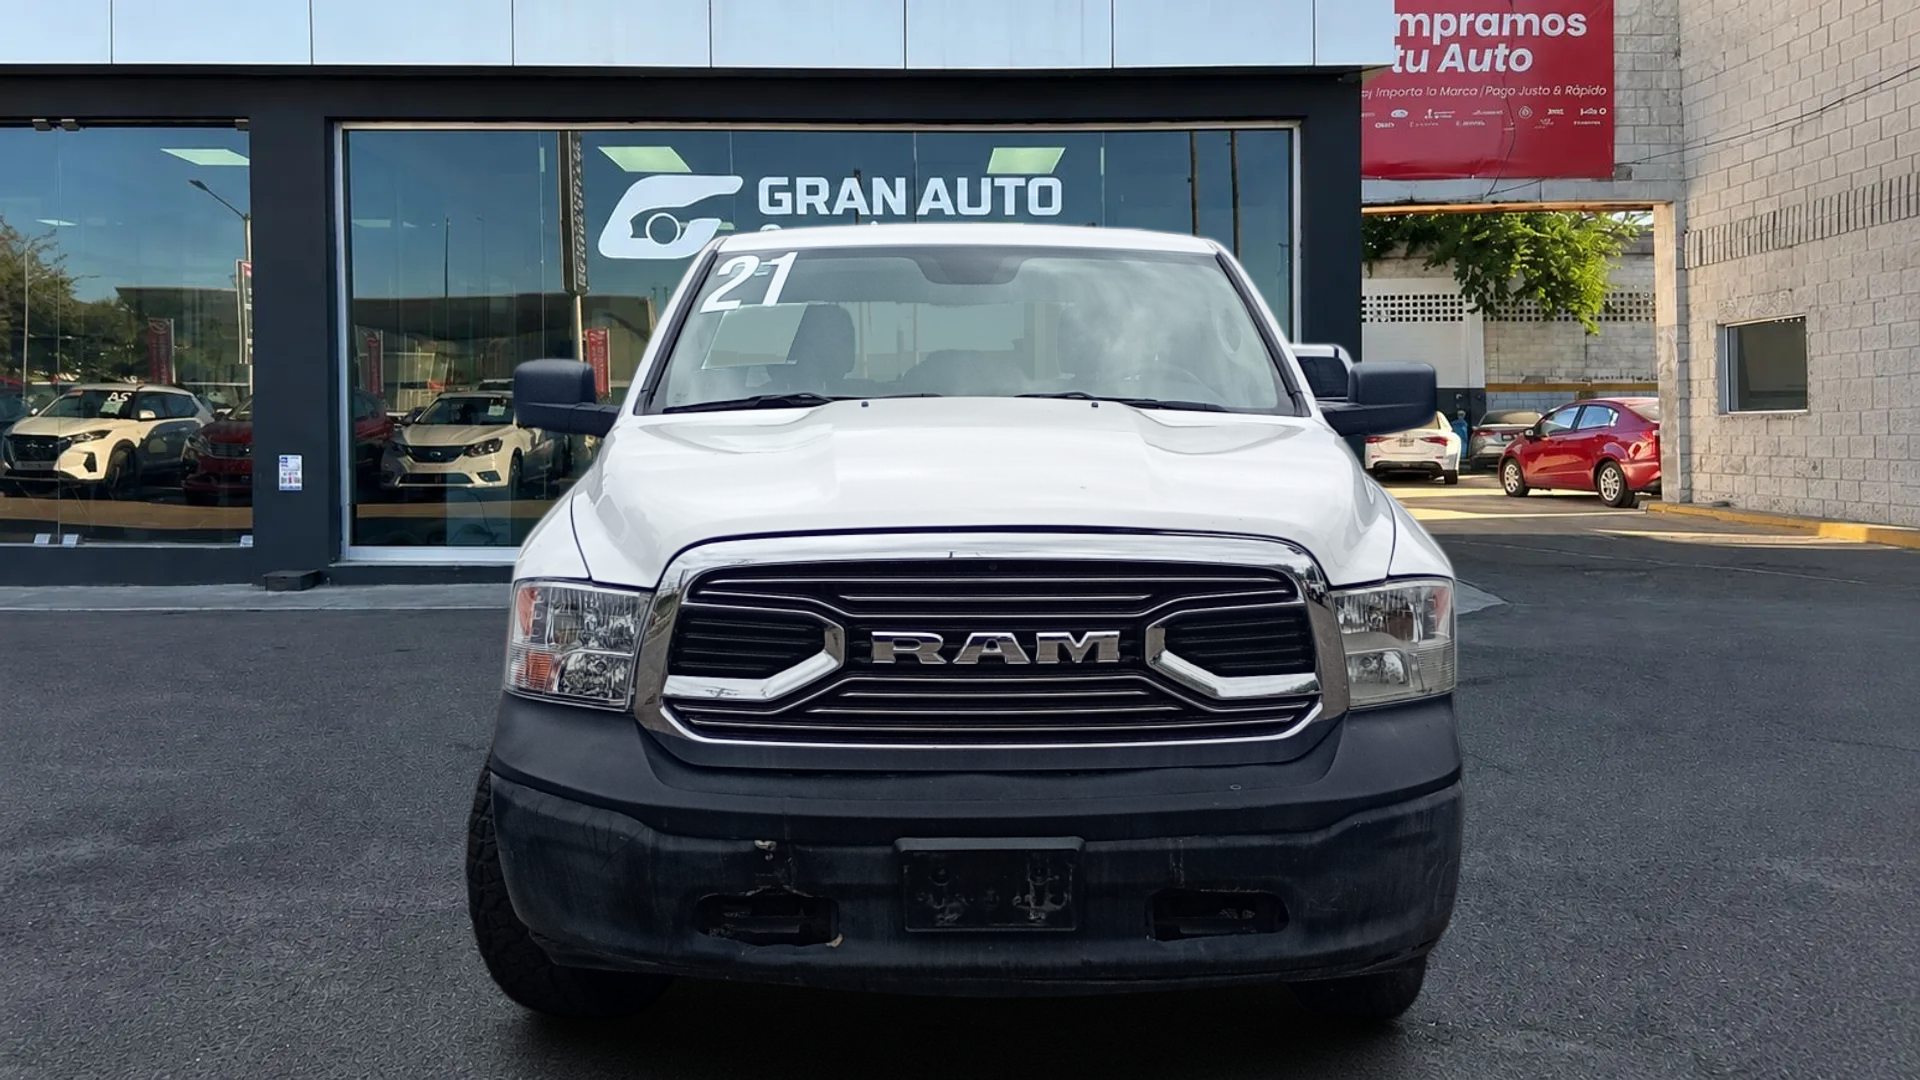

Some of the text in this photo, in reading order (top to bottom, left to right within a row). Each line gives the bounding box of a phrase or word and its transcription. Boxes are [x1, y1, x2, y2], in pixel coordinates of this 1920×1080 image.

[1392, 43, 1534, 74] tu Auto
[1375, 86, 1423, 100] Importa
[1426, 86, 1438, 97] la
[1440, 86, 1478, 97] Marca
[1518, 86, 1551, 96] Justo
[1553, 85, 1562, 96] &
[1565, 84, 1607, 98] Rápido
[758, 176, 1063, 216] GRAN AUTO
[699, 251, 799, 314] 21
[870, 631, 1121, 664] RAM
